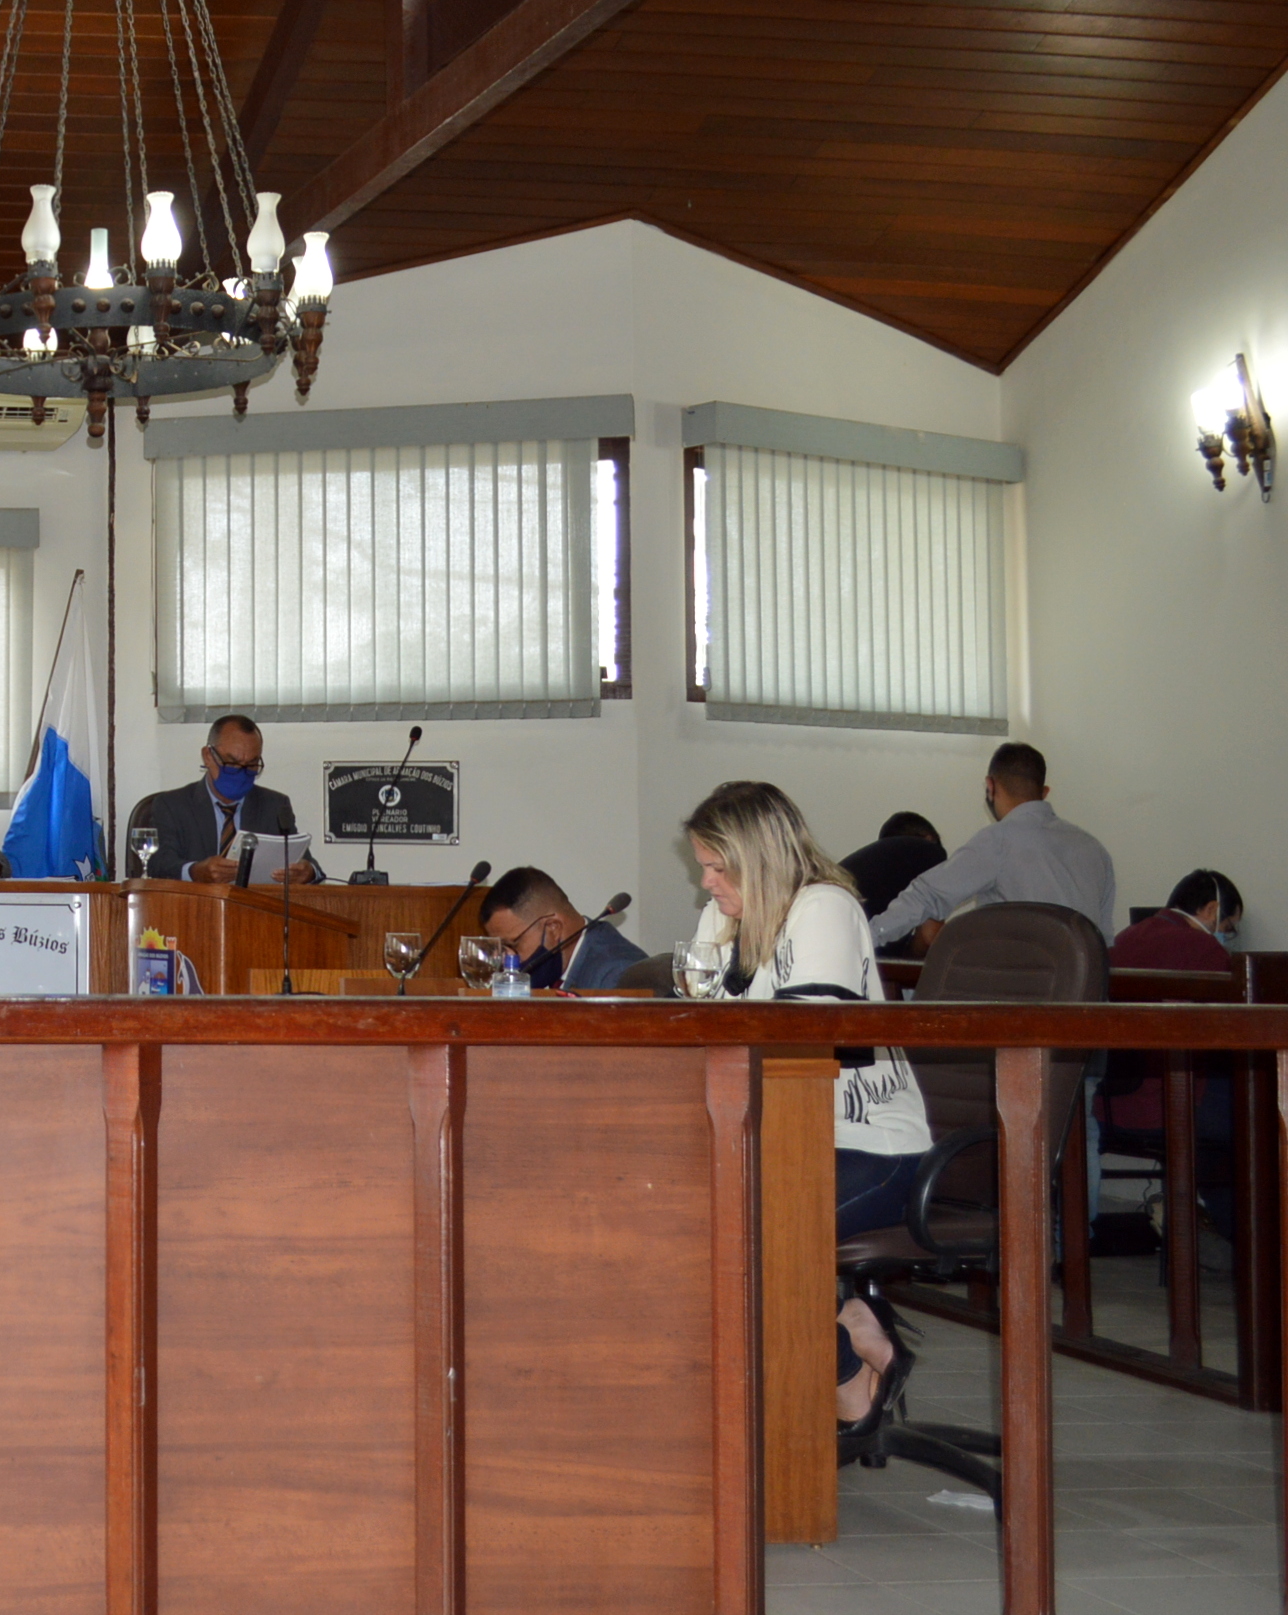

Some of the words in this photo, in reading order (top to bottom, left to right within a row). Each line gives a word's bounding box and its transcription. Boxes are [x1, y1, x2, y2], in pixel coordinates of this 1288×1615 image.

[328, 774, 353, 791] CÂMARA
[352, 767, 383, 782] MUNICIPAL
[383, 766, 393, 776] DE
[420, 770, 433, 782] DOS
[432, 771, 454, 791] BÚZIOS
[372, 808, 408, 816] PLNÁRIO
[410, 824, 441, 834] COUTINHO
[10, 926, 70, 955] Búzios
